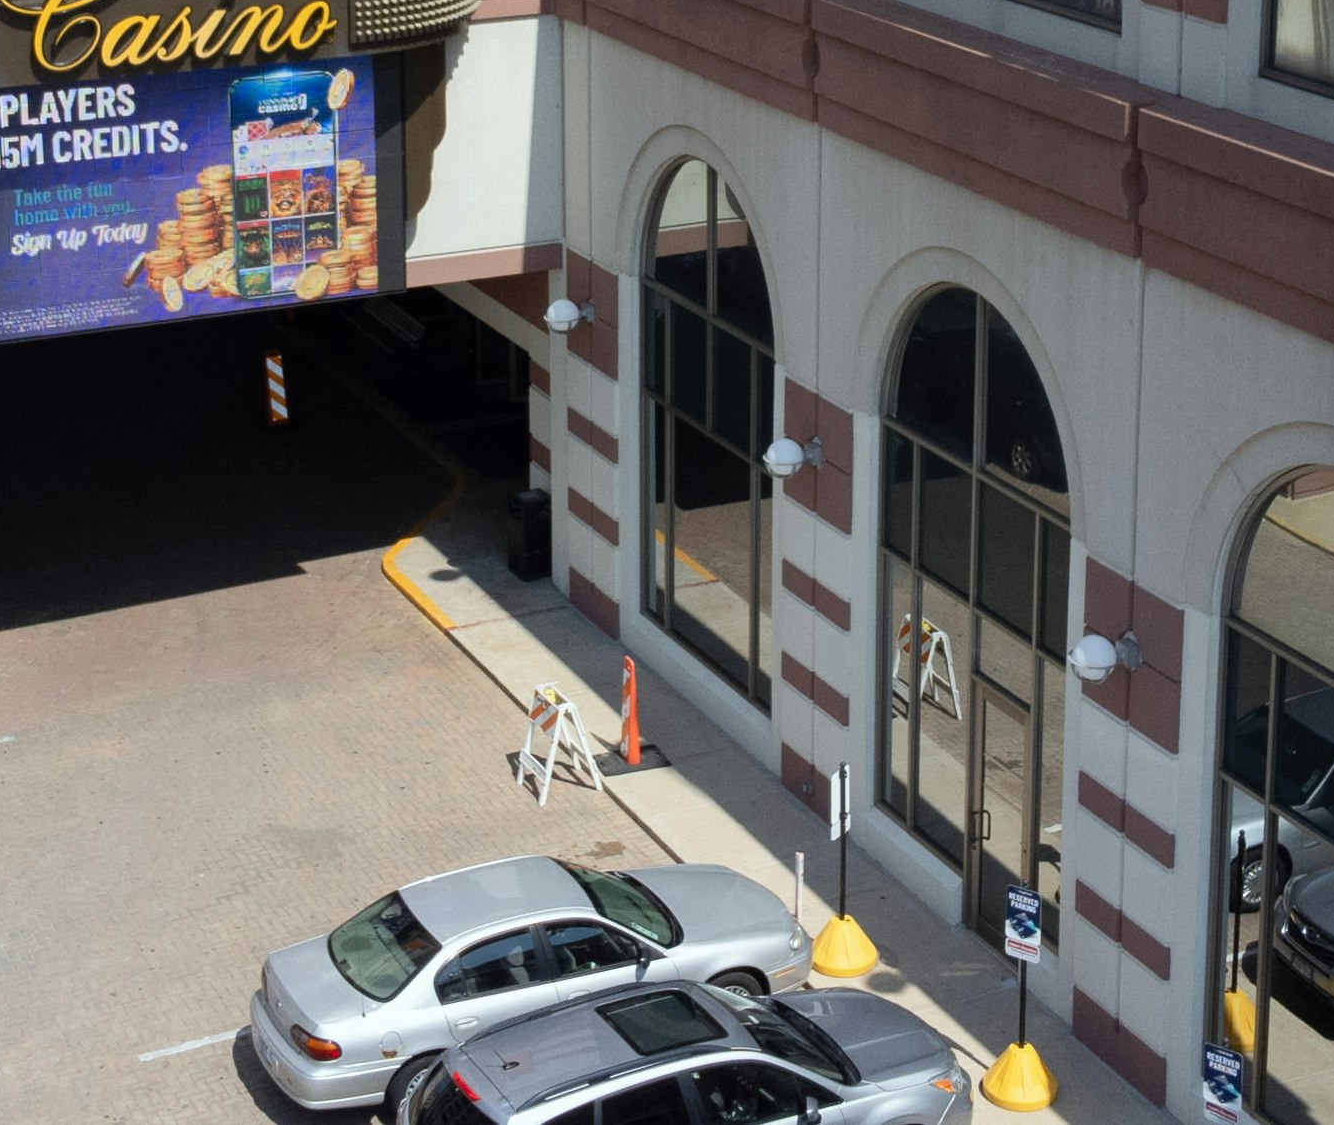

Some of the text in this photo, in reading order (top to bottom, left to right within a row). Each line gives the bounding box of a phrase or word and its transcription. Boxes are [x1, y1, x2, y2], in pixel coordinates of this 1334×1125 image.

[0, 83, 136, 129] PLAYERS
[52, 120, 188, 163] CREDITS.
[13, 181, 113, 207] Take the fun
[14, 208, 60, 226] home
[63, 201, 98, 220] with
[11, 222, 149, 256] Sign Up Today
[1008, 892, 1039, 907] RESERVED
[1010, 899, 1037, 914] PARKING
[1207, 1051, 1240, 1070] RESERVED
[1209, 1060, 1238, 1077] PARKING
